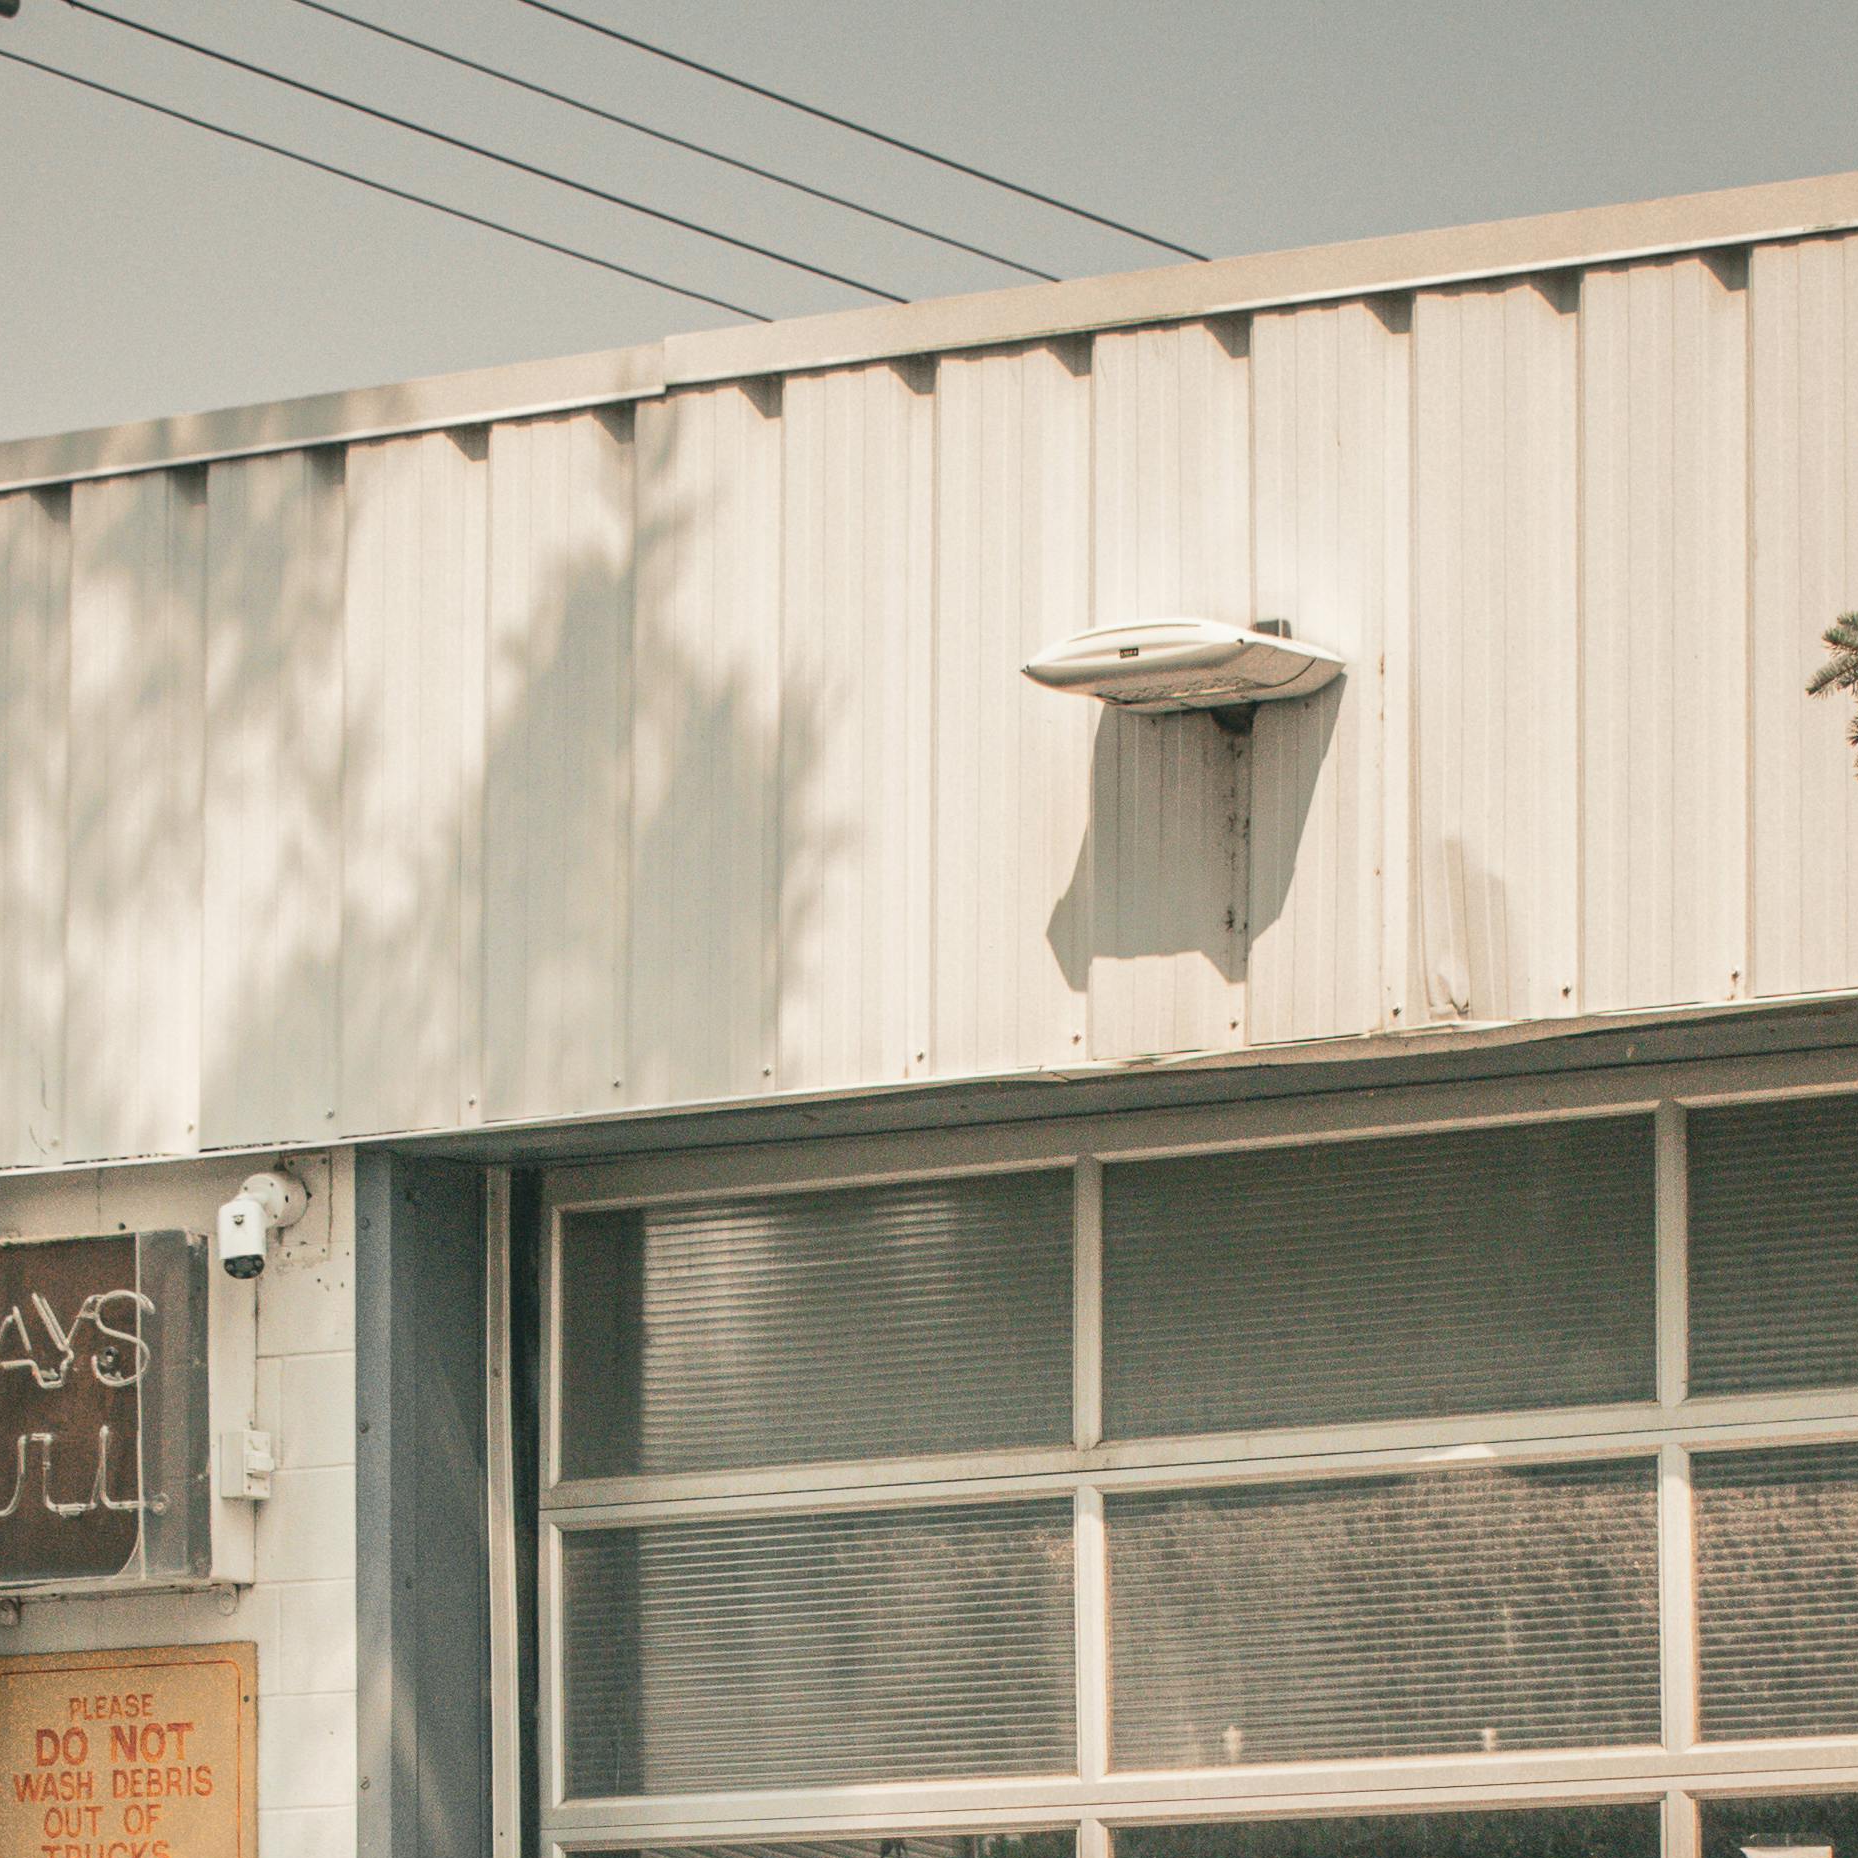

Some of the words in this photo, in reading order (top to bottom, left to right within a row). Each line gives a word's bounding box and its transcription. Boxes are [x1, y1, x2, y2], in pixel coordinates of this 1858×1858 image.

[69, 1694, 154, 1719] PLEASE
[35, 1727, 88, 1766] DO
[111, 1722, 193, 1762] NOT
[14, 1771, 93, 1801] WASH
[112, 1766, 213, 1798] DEBRIS
[43, 1806, 103, 1838] OUT
[124, 1804, 161, 1836] OF
